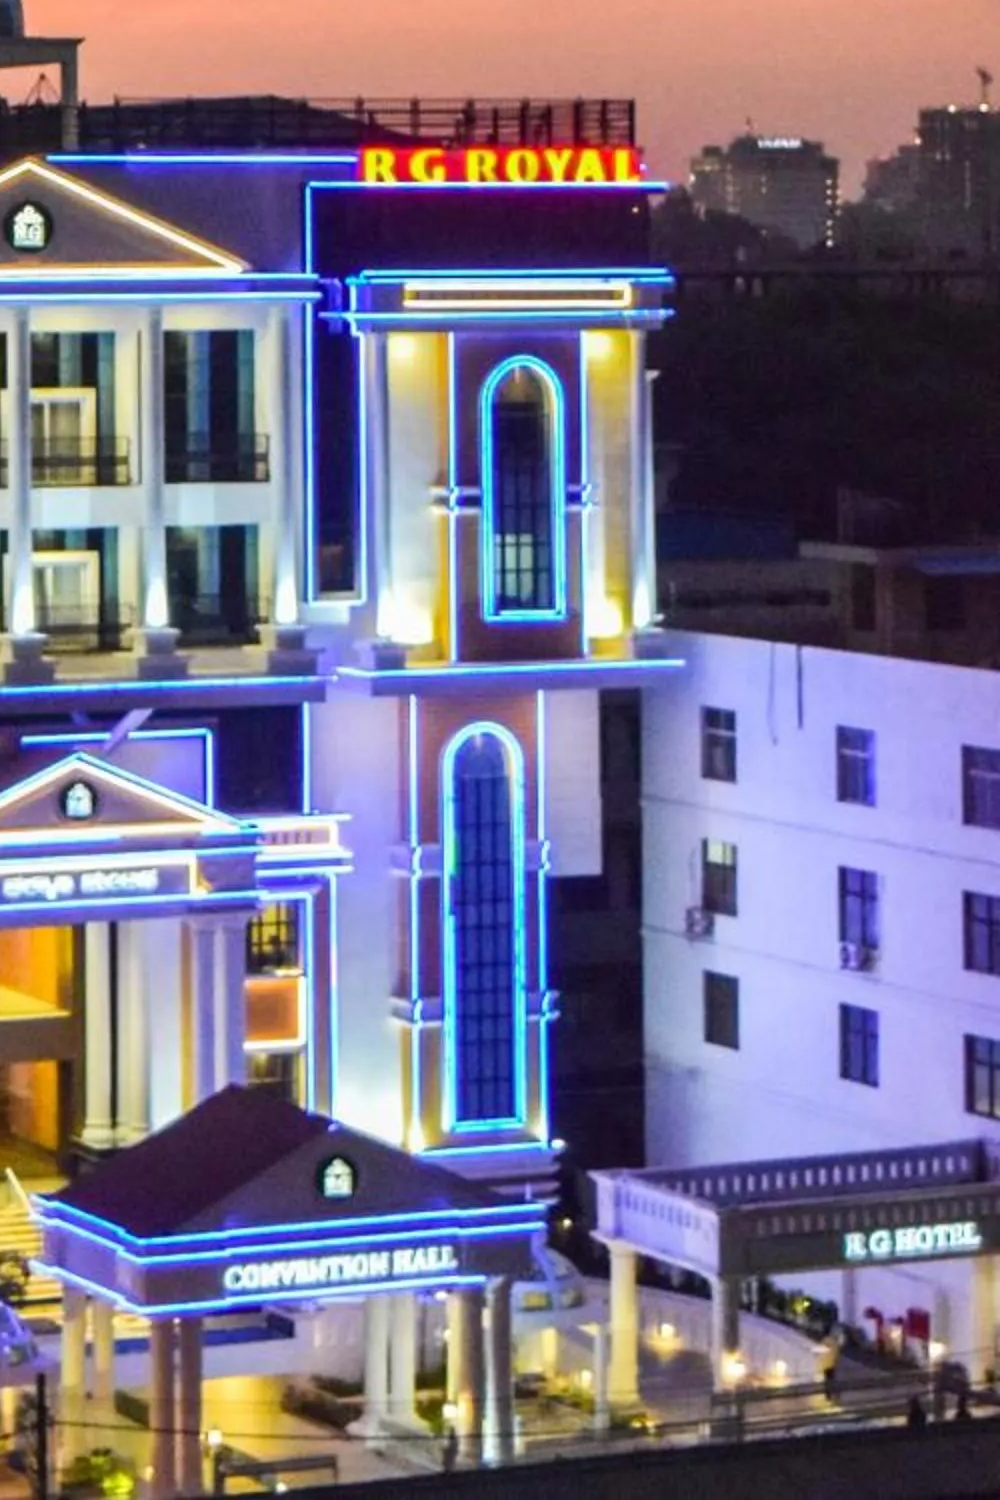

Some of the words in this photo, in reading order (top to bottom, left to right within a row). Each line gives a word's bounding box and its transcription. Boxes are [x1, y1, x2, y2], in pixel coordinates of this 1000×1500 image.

[466, 147, 640, 184] ROYAL
[894, 1221, 982, 1255] HOTEL
[223, 1251, 389, 1290] CONVENTION
[392, 1245, 458, 1276] HALL
